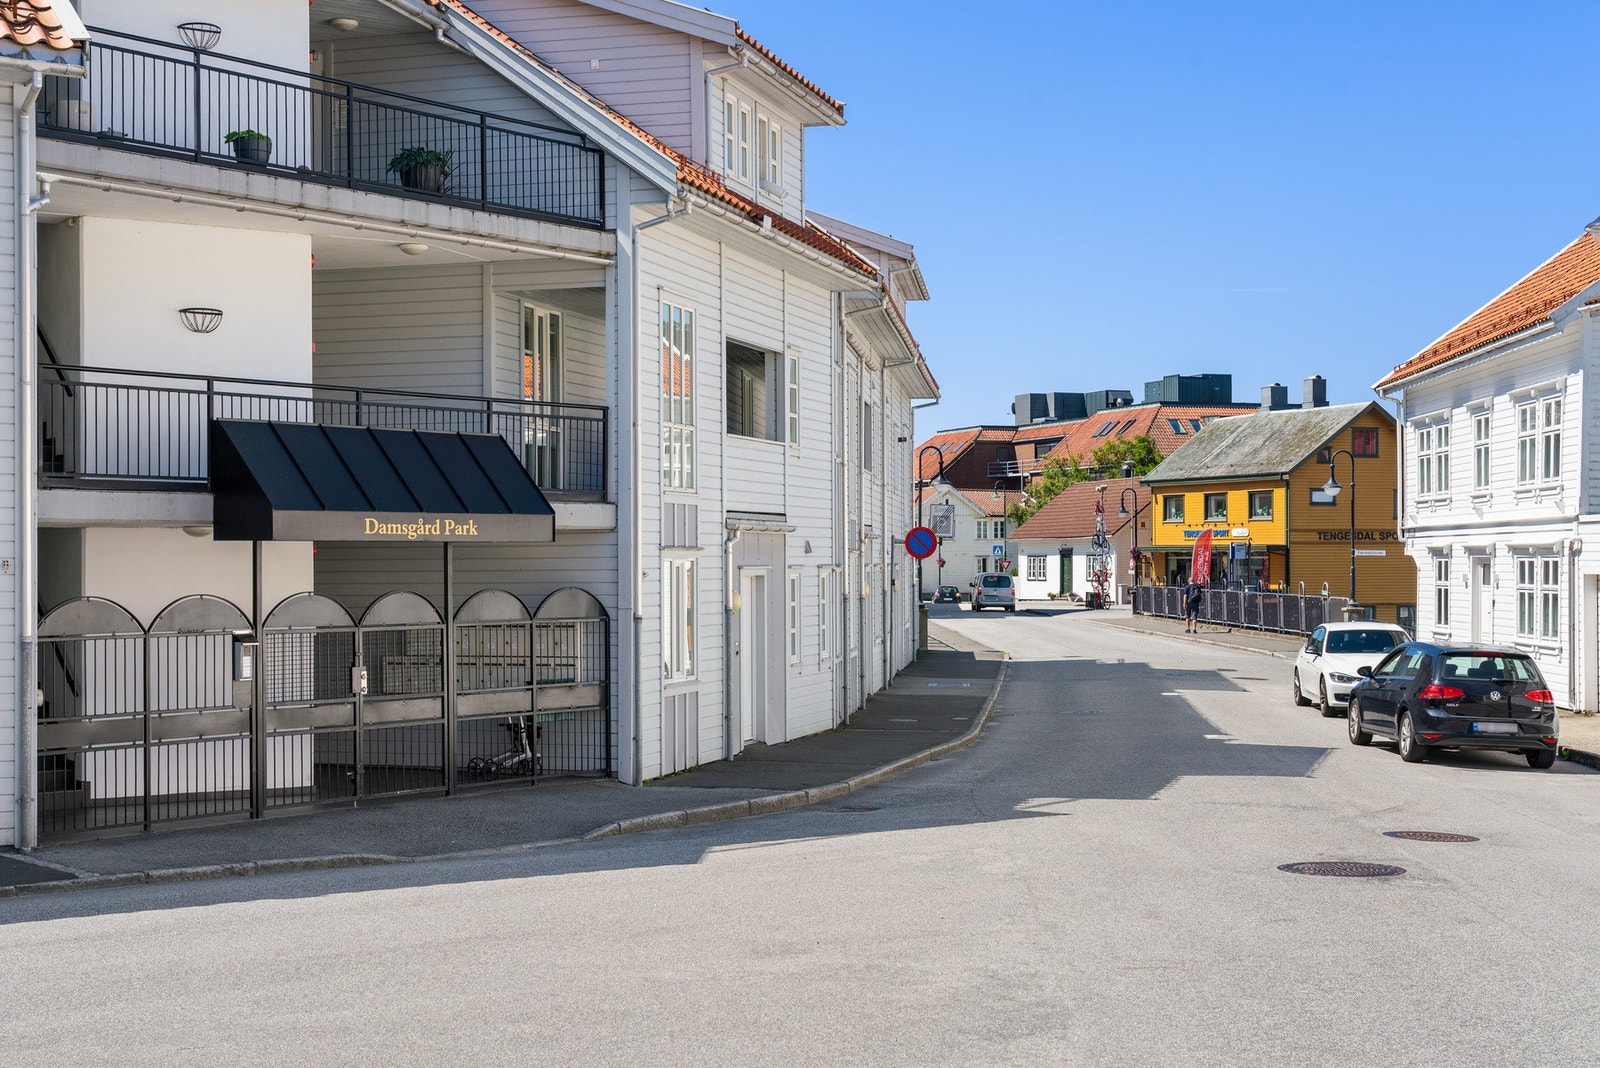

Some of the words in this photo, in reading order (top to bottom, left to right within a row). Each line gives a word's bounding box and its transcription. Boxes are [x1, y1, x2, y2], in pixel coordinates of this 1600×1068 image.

[364, 517, 441, 540] Damsgård
[444, 519, 478, 536] Park
[1317, 531, 1376, 541] TENGEDAL
